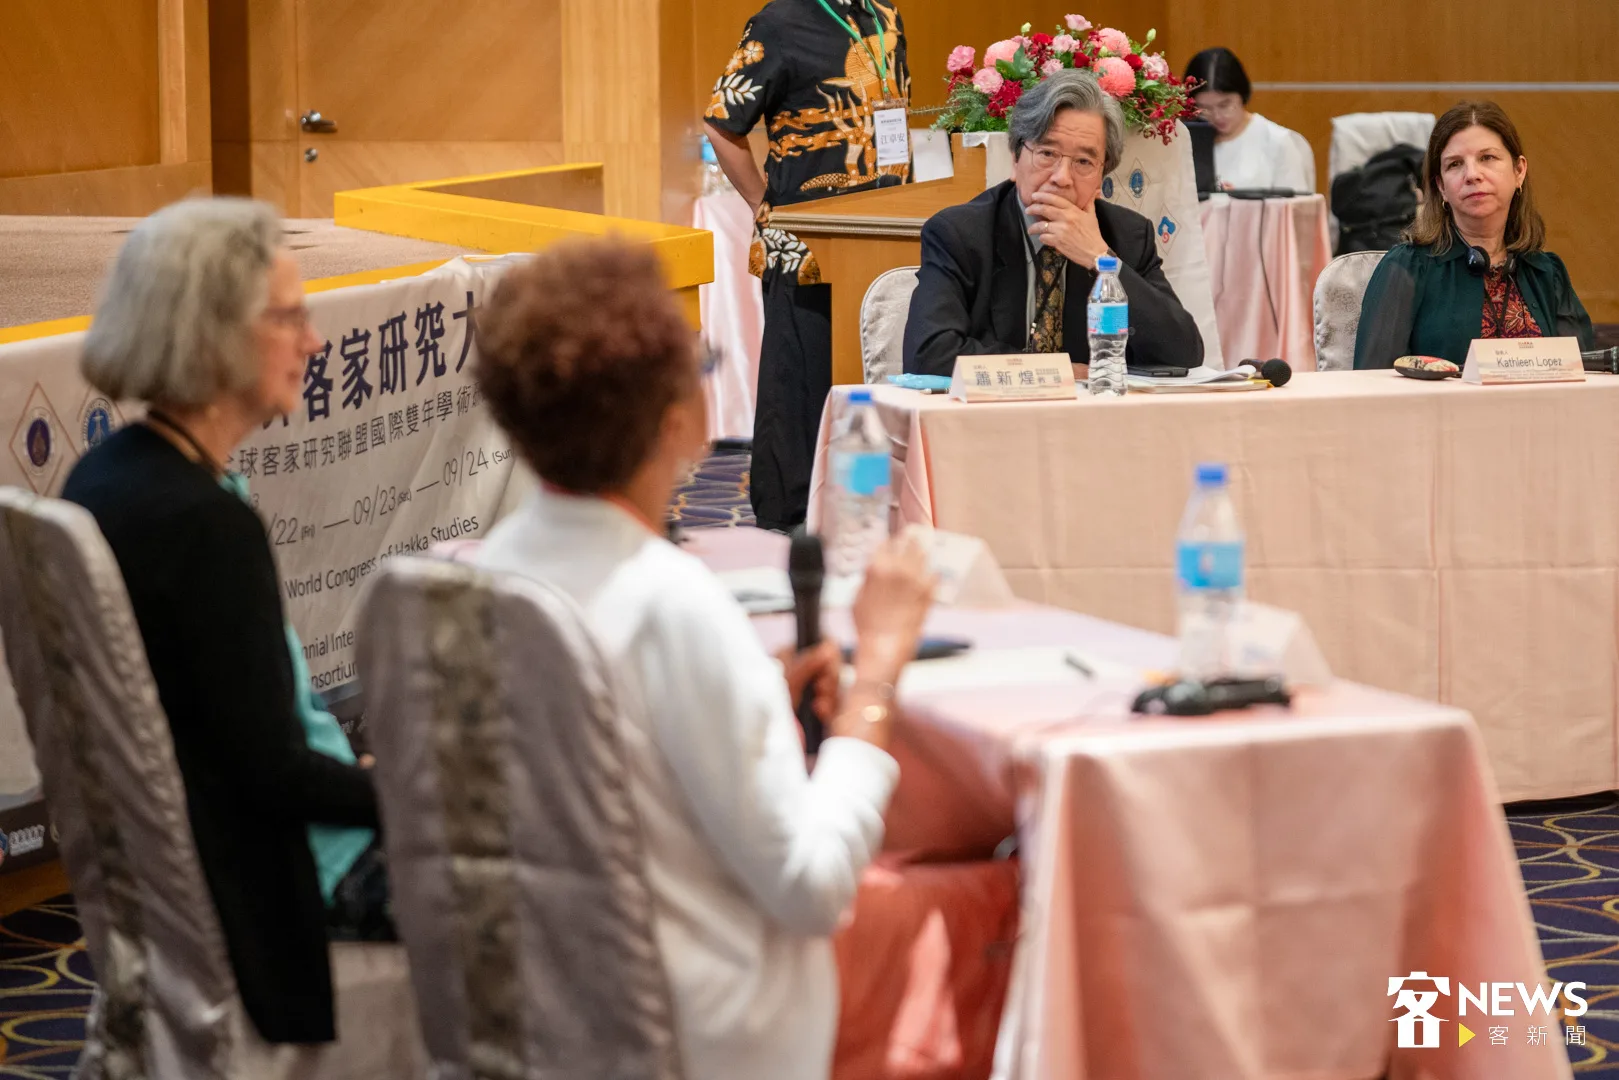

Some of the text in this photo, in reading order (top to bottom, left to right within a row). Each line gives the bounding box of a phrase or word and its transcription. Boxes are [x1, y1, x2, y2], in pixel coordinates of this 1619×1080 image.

[262, 291, 483, 430] 客家研究大
[1496, 356, 1564, 368] Kathleen Lopez
[229, 382, 483, 479] 球客家研究聯盟國際雙年學術
[353, 484, 396, 525] 09/23
[443, 446, 489, 486] 09/24
[285, 571, 322, 598] World
[326, 556, 377, 590] Congress
[395, 533, 429, 557] Hakka
[430, 515, 480, 543] Studies
